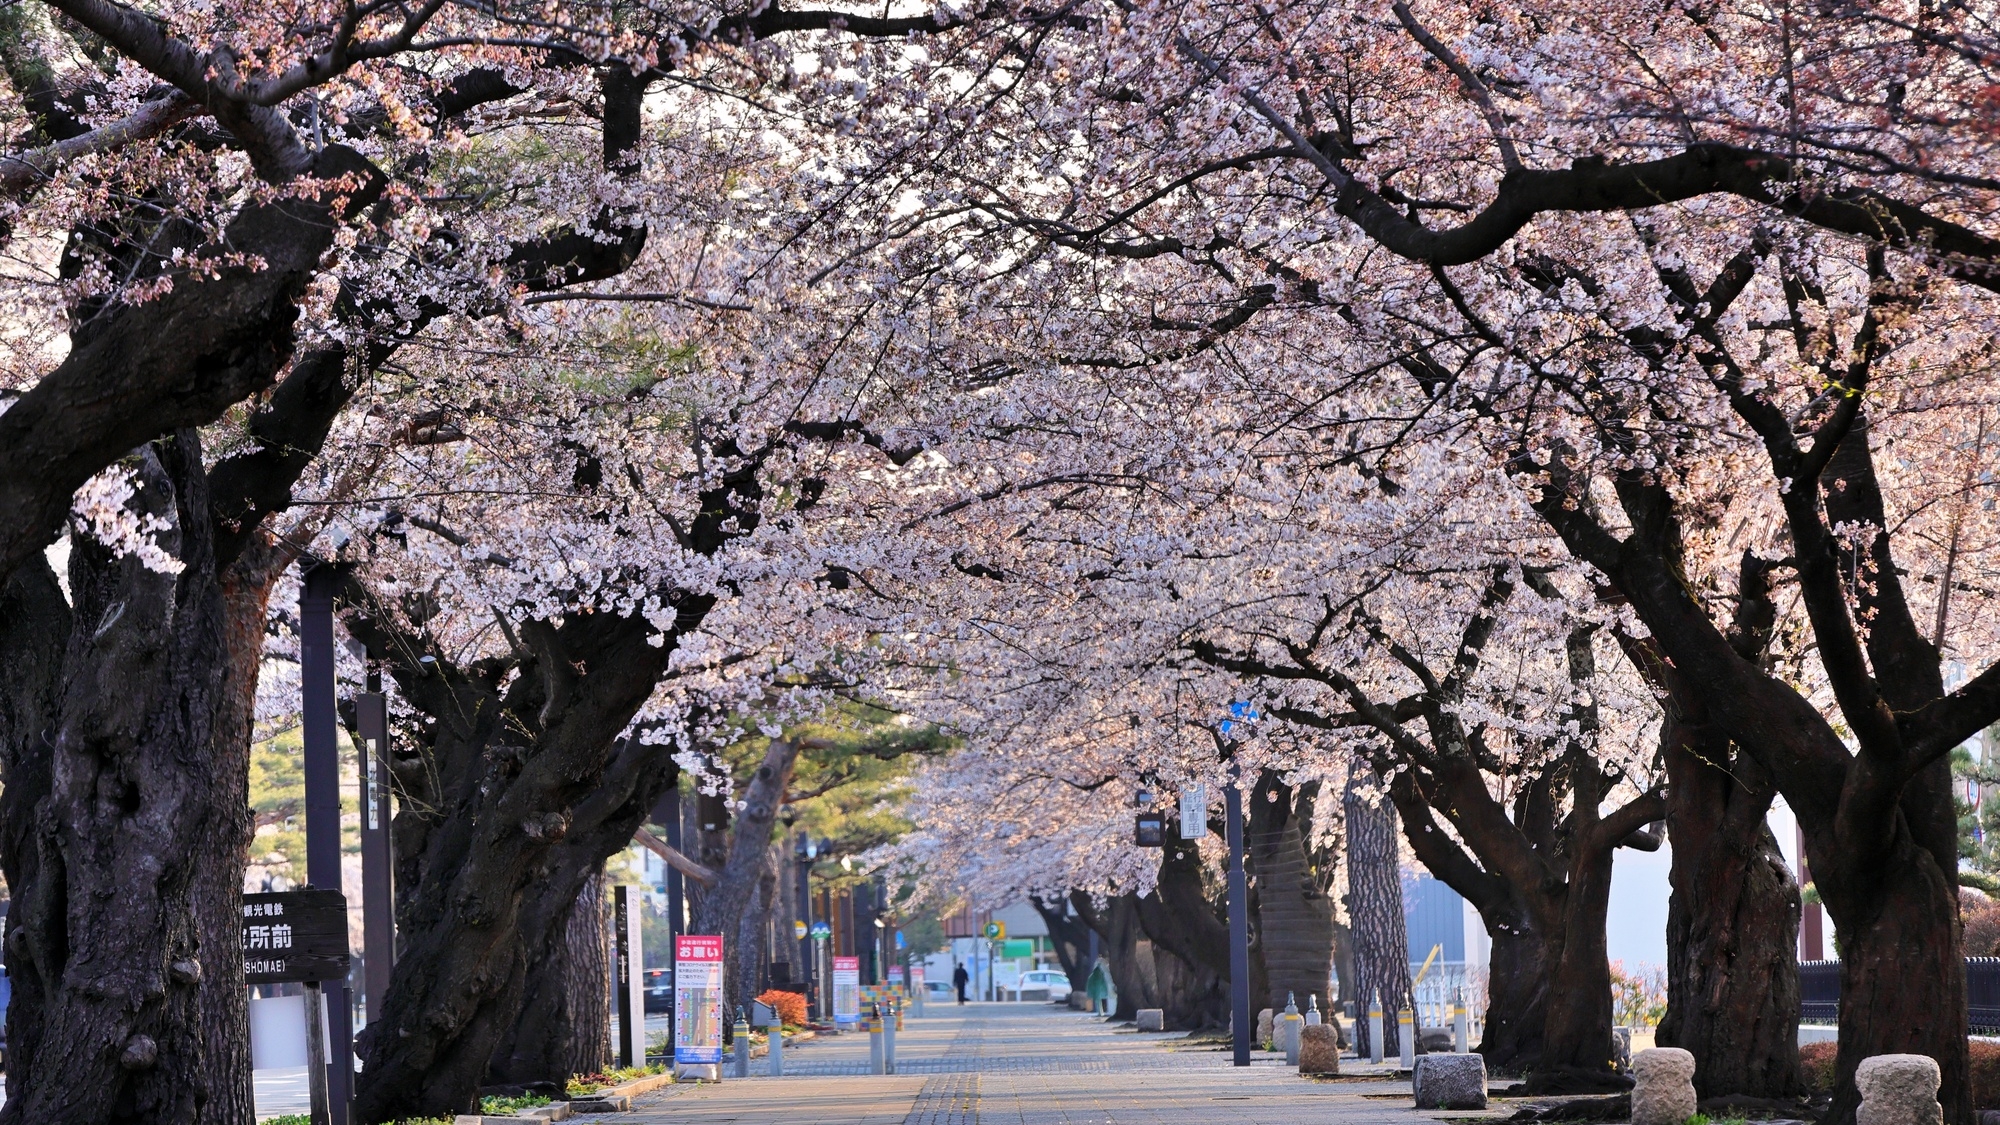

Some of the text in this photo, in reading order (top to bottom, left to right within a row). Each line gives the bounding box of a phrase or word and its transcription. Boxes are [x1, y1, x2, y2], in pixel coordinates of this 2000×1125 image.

[243, 903, 284, 917] 観光電鉄
[680, 946, 719, 958] お願い
[245, 960, 286, 974] SHOMAE)
